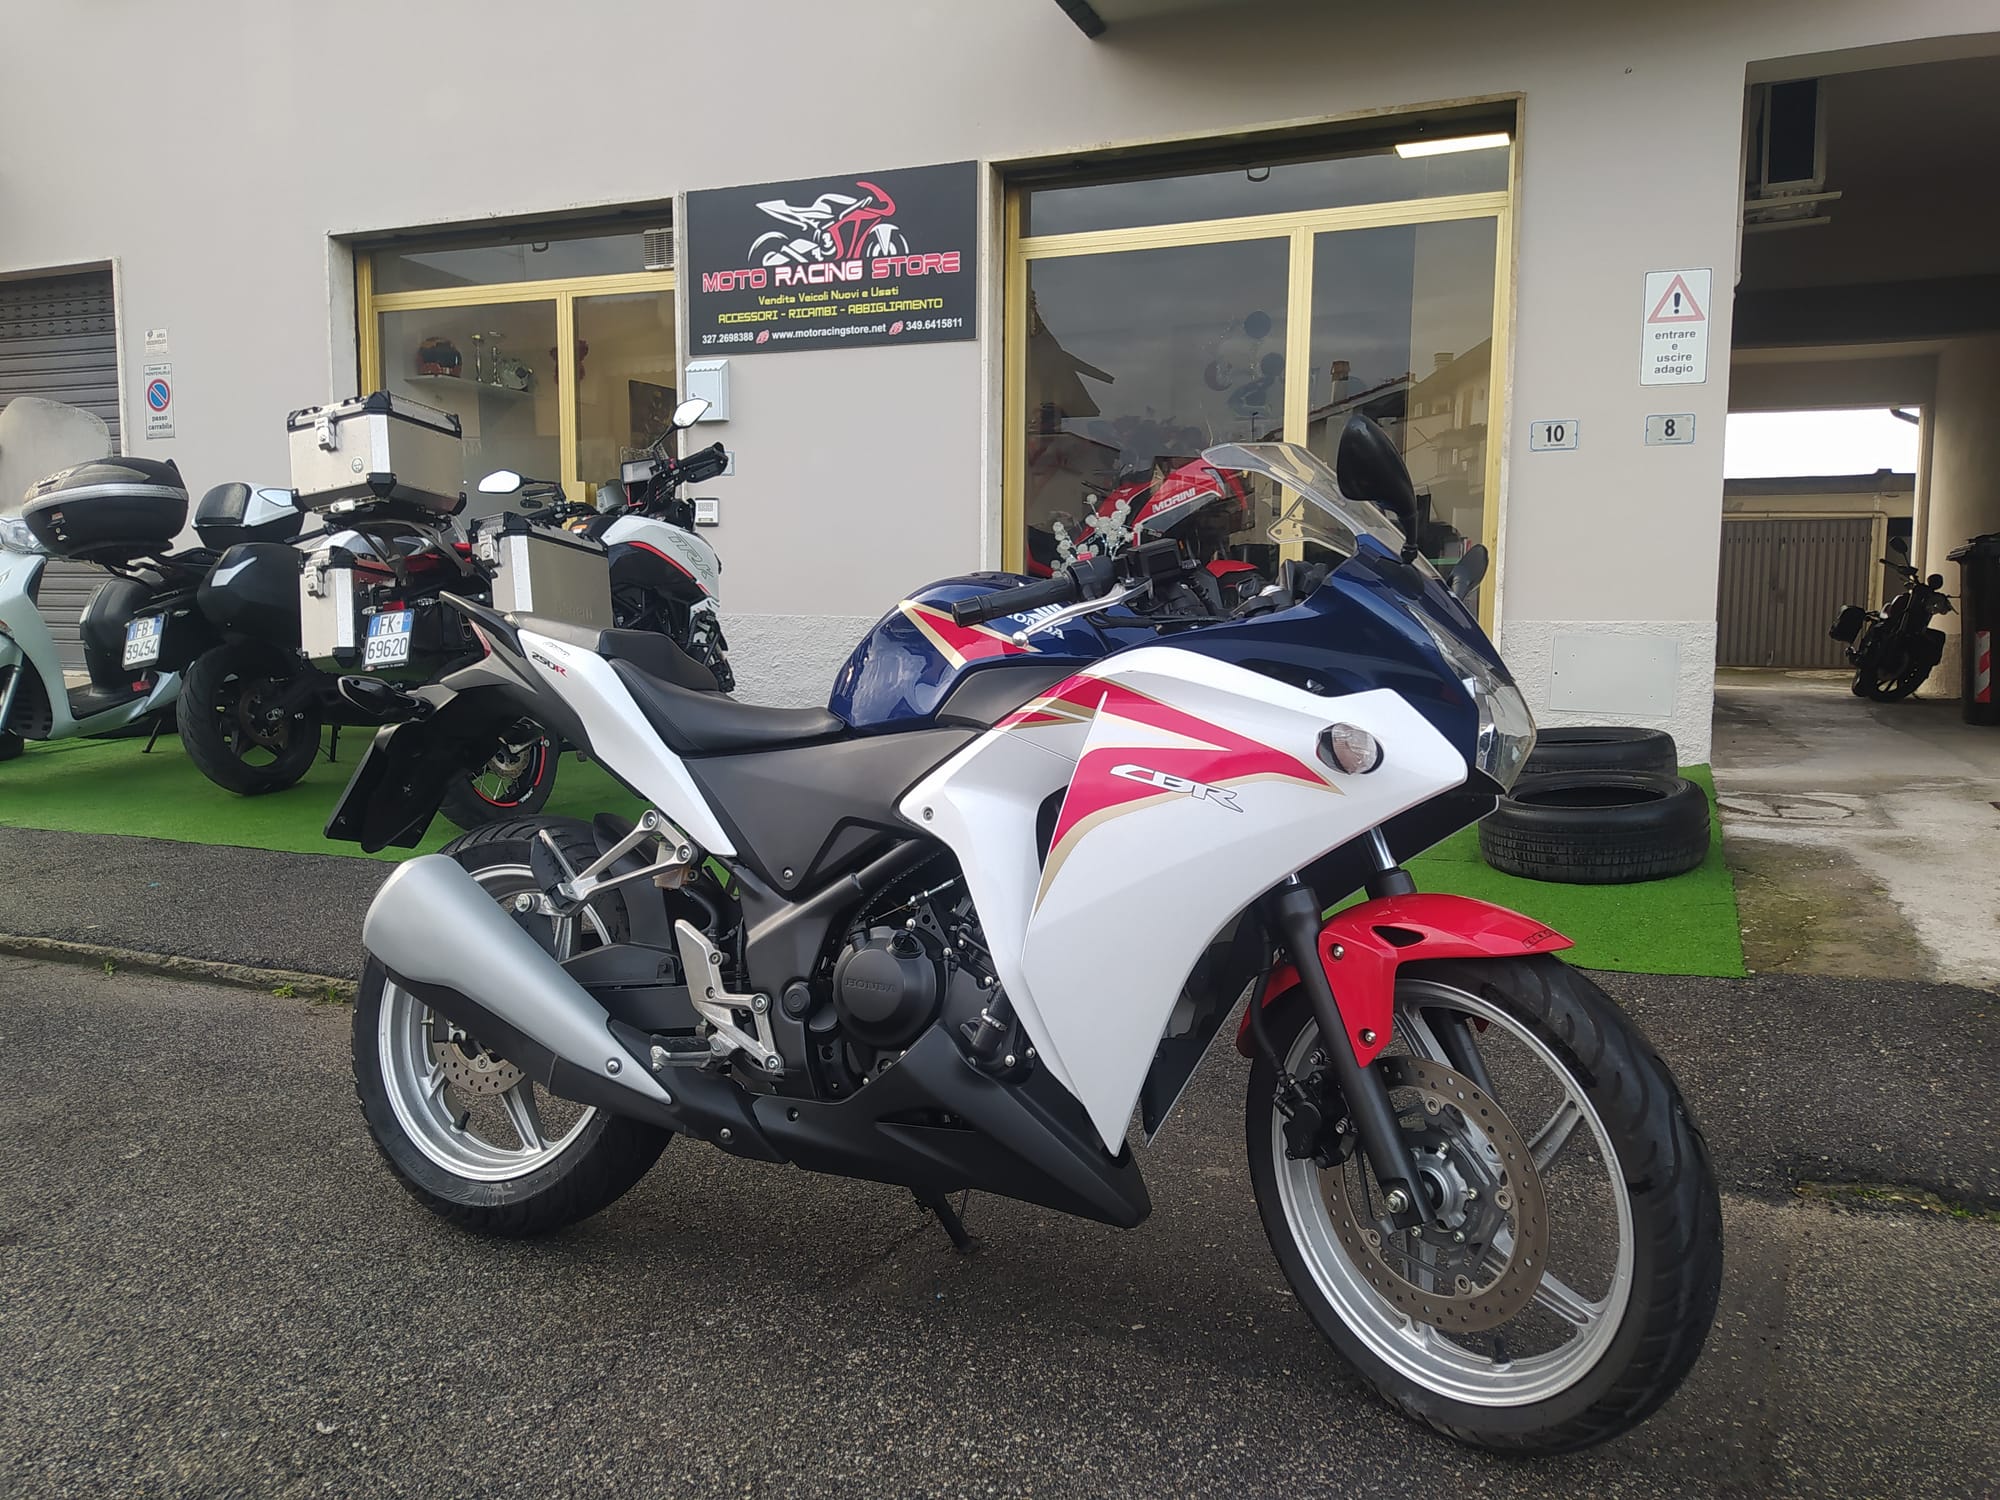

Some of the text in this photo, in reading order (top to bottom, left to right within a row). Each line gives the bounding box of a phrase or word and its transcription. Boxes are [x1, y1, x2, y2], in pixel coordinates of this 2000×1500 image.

[703, 251, 960, 293] MOTO RACING STORE
[758, 286, 899, 305] Vendita Veicoli Nuovi e Usati
[718, 310, 778, 324] ACCESSORI
[788, 305, 837, 319] RICAMBI
[848, 298, 943, 314] ABBIGLIAMENTO
[702, 318, 962, 344] 327.2698388 www.motoracingstore.net 349.6415811
[1655, 330, 1696, 340] entrare
[1657, 352, 1692, 362] uscire
[1654, 363, 1693, 375] adagio
[1546, 425, 1564, 442] 10
[1664, 418, 1675, 437] 8
[1152, 487, 1196, 513] MORINI
[136, 620, 149, 637] FB
[380, 614, 397, 634] FK
[126, 639, 157, 660] 39454
[367, 637, 408, 660] 69620
[532, 651, 568, 678] 250R
[1110, 764, 1244, 813] CBR
